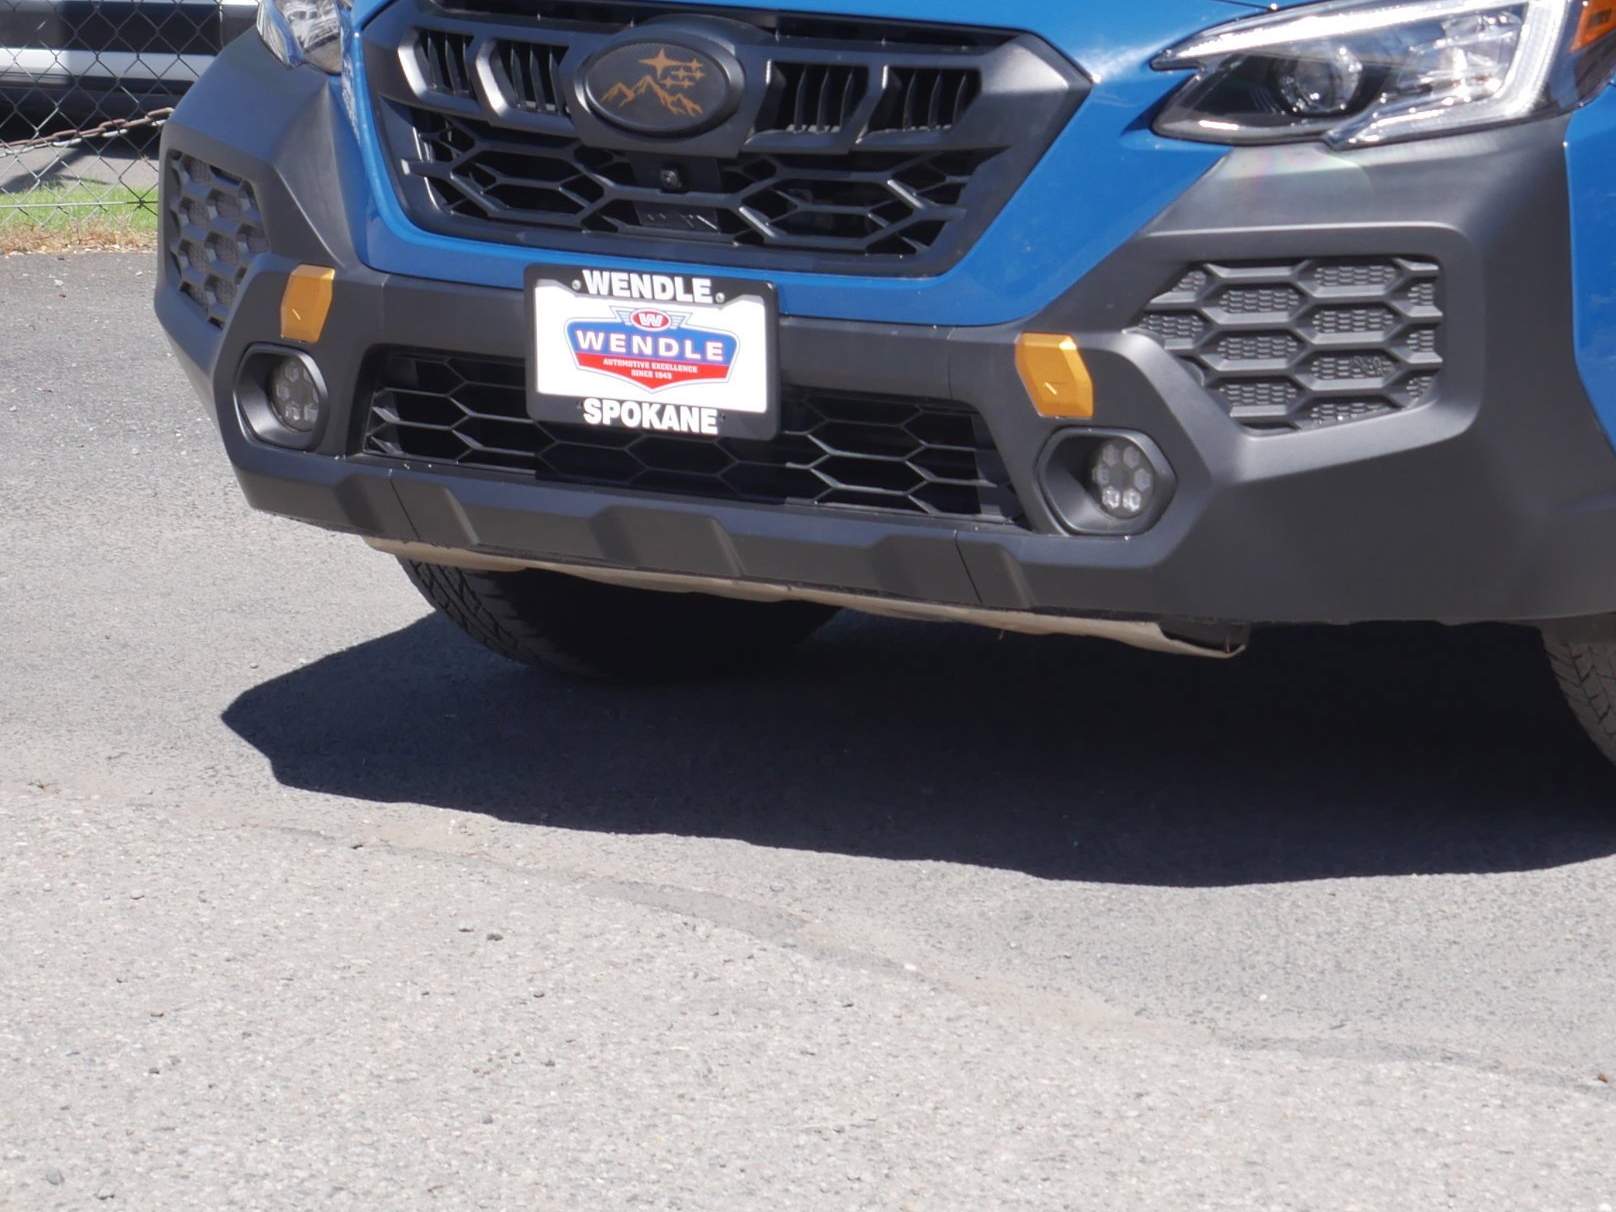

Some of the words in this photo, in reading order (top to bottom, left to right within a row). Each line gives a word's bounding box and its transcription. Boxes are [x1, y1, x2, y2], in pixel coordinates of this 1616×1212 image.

[581, 269, 714, 304] WENDLE
[575, 329, 724, 362] WENDLE
[603, 358, 651, 370] AUTOMOTIVE
[651, 362, 698, 374] EXCELLENCE
[630, 369, 654, 378] SINCE
[654, 370, 673, 380] 1943
[582, 397, 719, 435] SPOKANE
